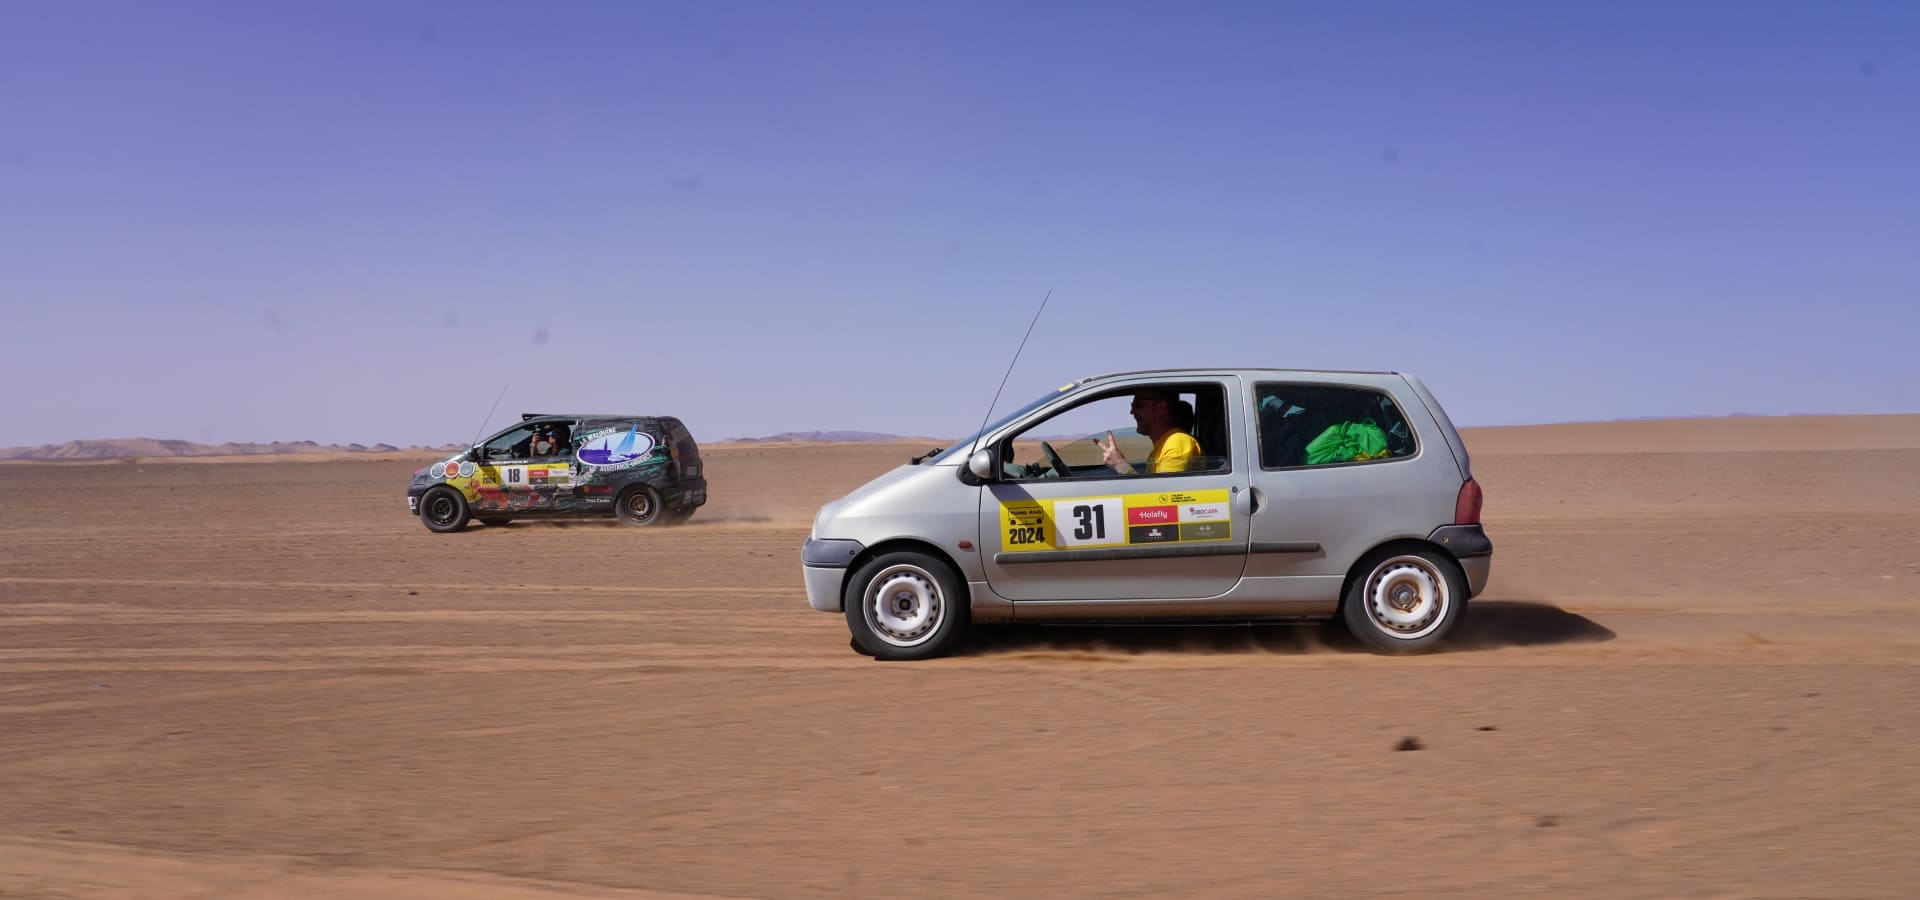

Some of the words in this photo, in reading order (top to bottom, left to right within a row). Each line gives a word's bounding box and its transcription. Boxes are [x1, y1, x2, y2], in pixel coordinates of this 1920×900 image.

[507, 468, 521, 483] 18
[1072, 504, 1106, 540] 31
[1138, 509, 1168, 520] Holafly
[1009, 527, 1046, 545] 2024
